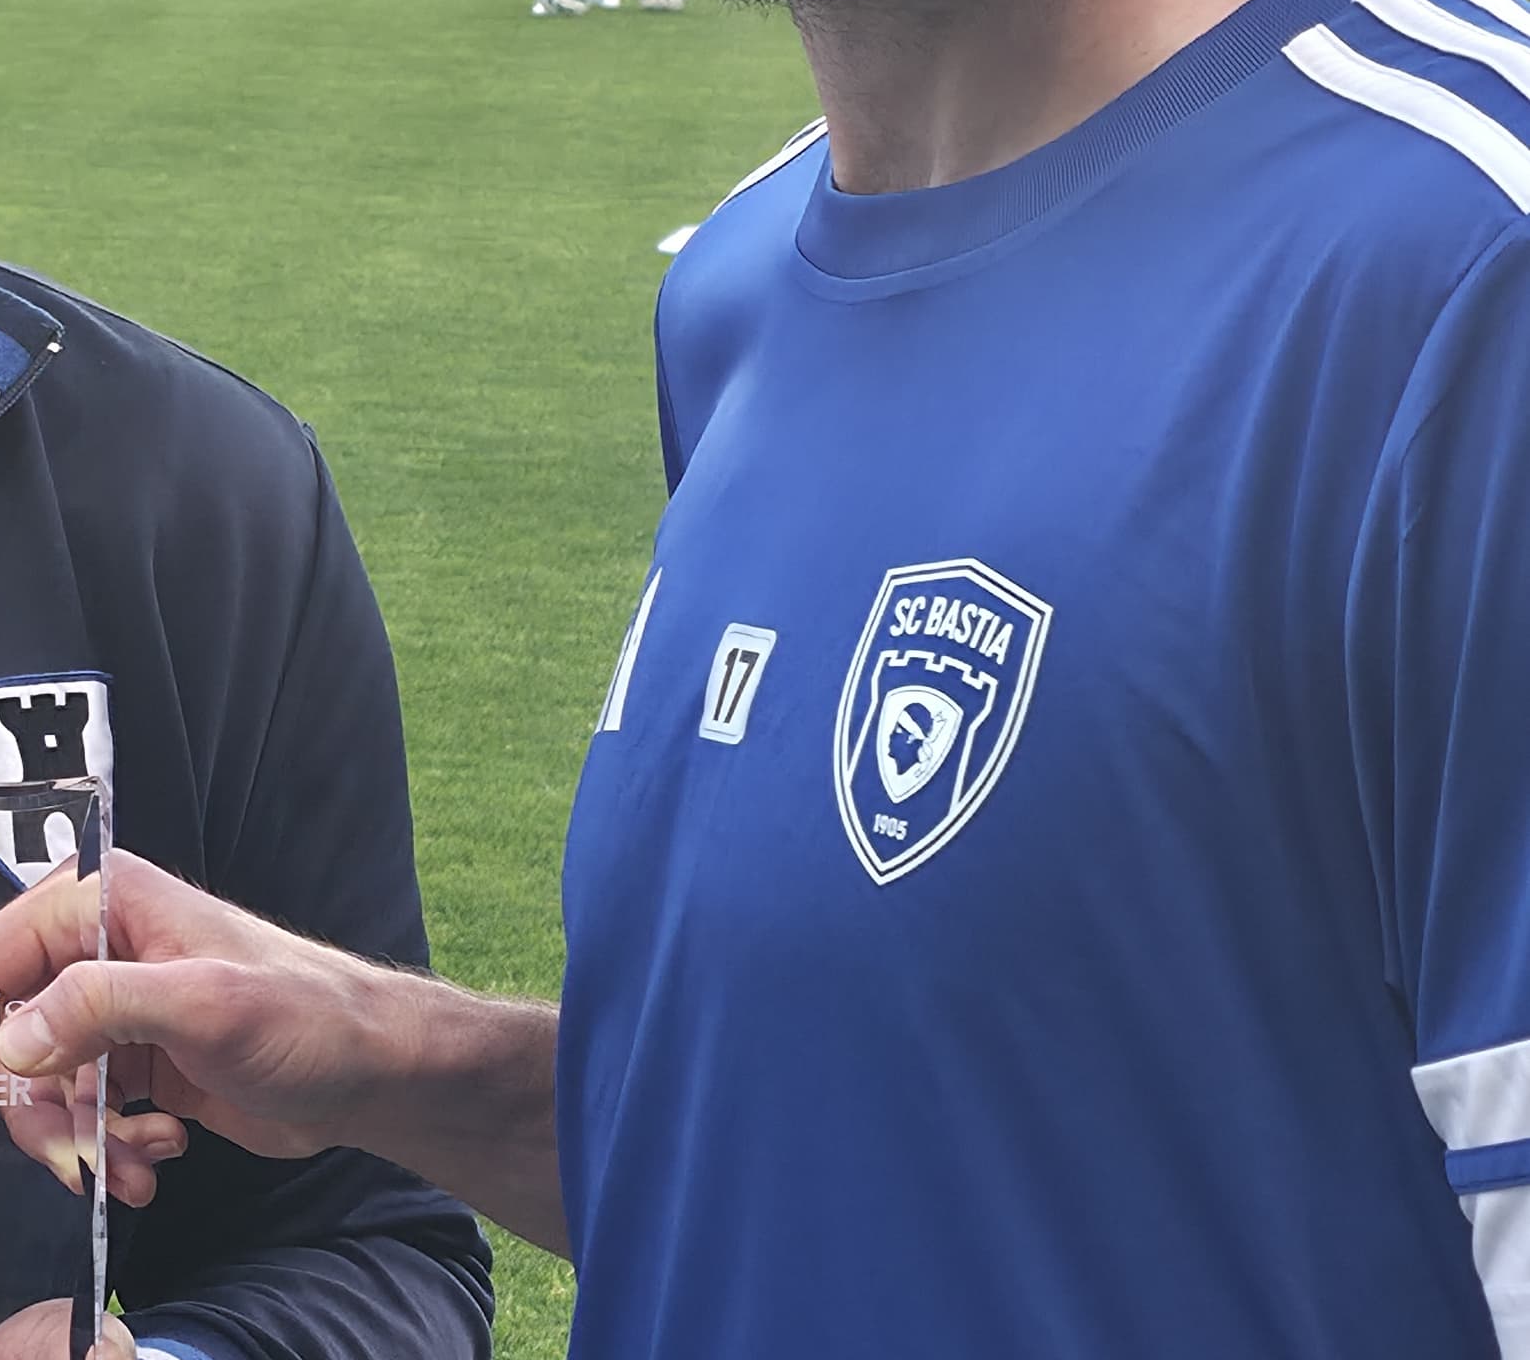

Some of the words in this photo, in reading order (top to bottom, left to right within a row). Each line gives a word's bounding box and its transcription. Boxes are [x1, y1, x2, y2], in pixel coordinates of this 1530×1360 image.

[890, 596, 927, 637] SC
[923, 596, 1014, 665] BASTIA
[713, 648, 760, 724] 17
[873, 813, 909, 841] 1905
